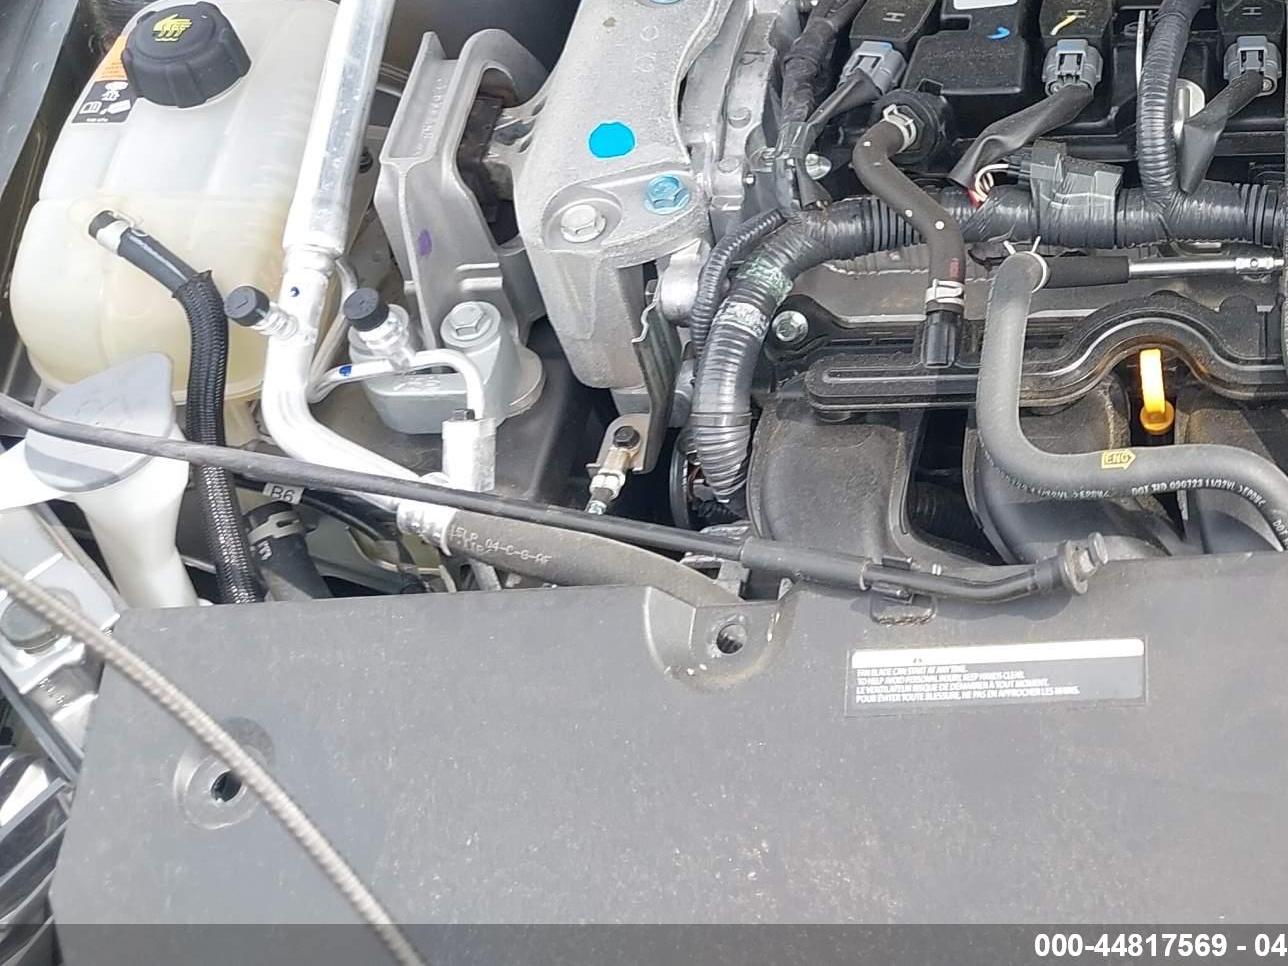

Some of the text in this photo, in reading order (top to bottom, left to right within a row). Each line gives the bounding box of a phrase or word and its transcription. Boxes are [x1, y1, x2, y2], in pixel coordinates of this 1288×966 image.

[1106, 453, 1129, 465] ENG
[271, 485, 295, 502] B6
[1131, 484, 1149, 496] DOT
[1272, 518, 1288, 536] DOT
